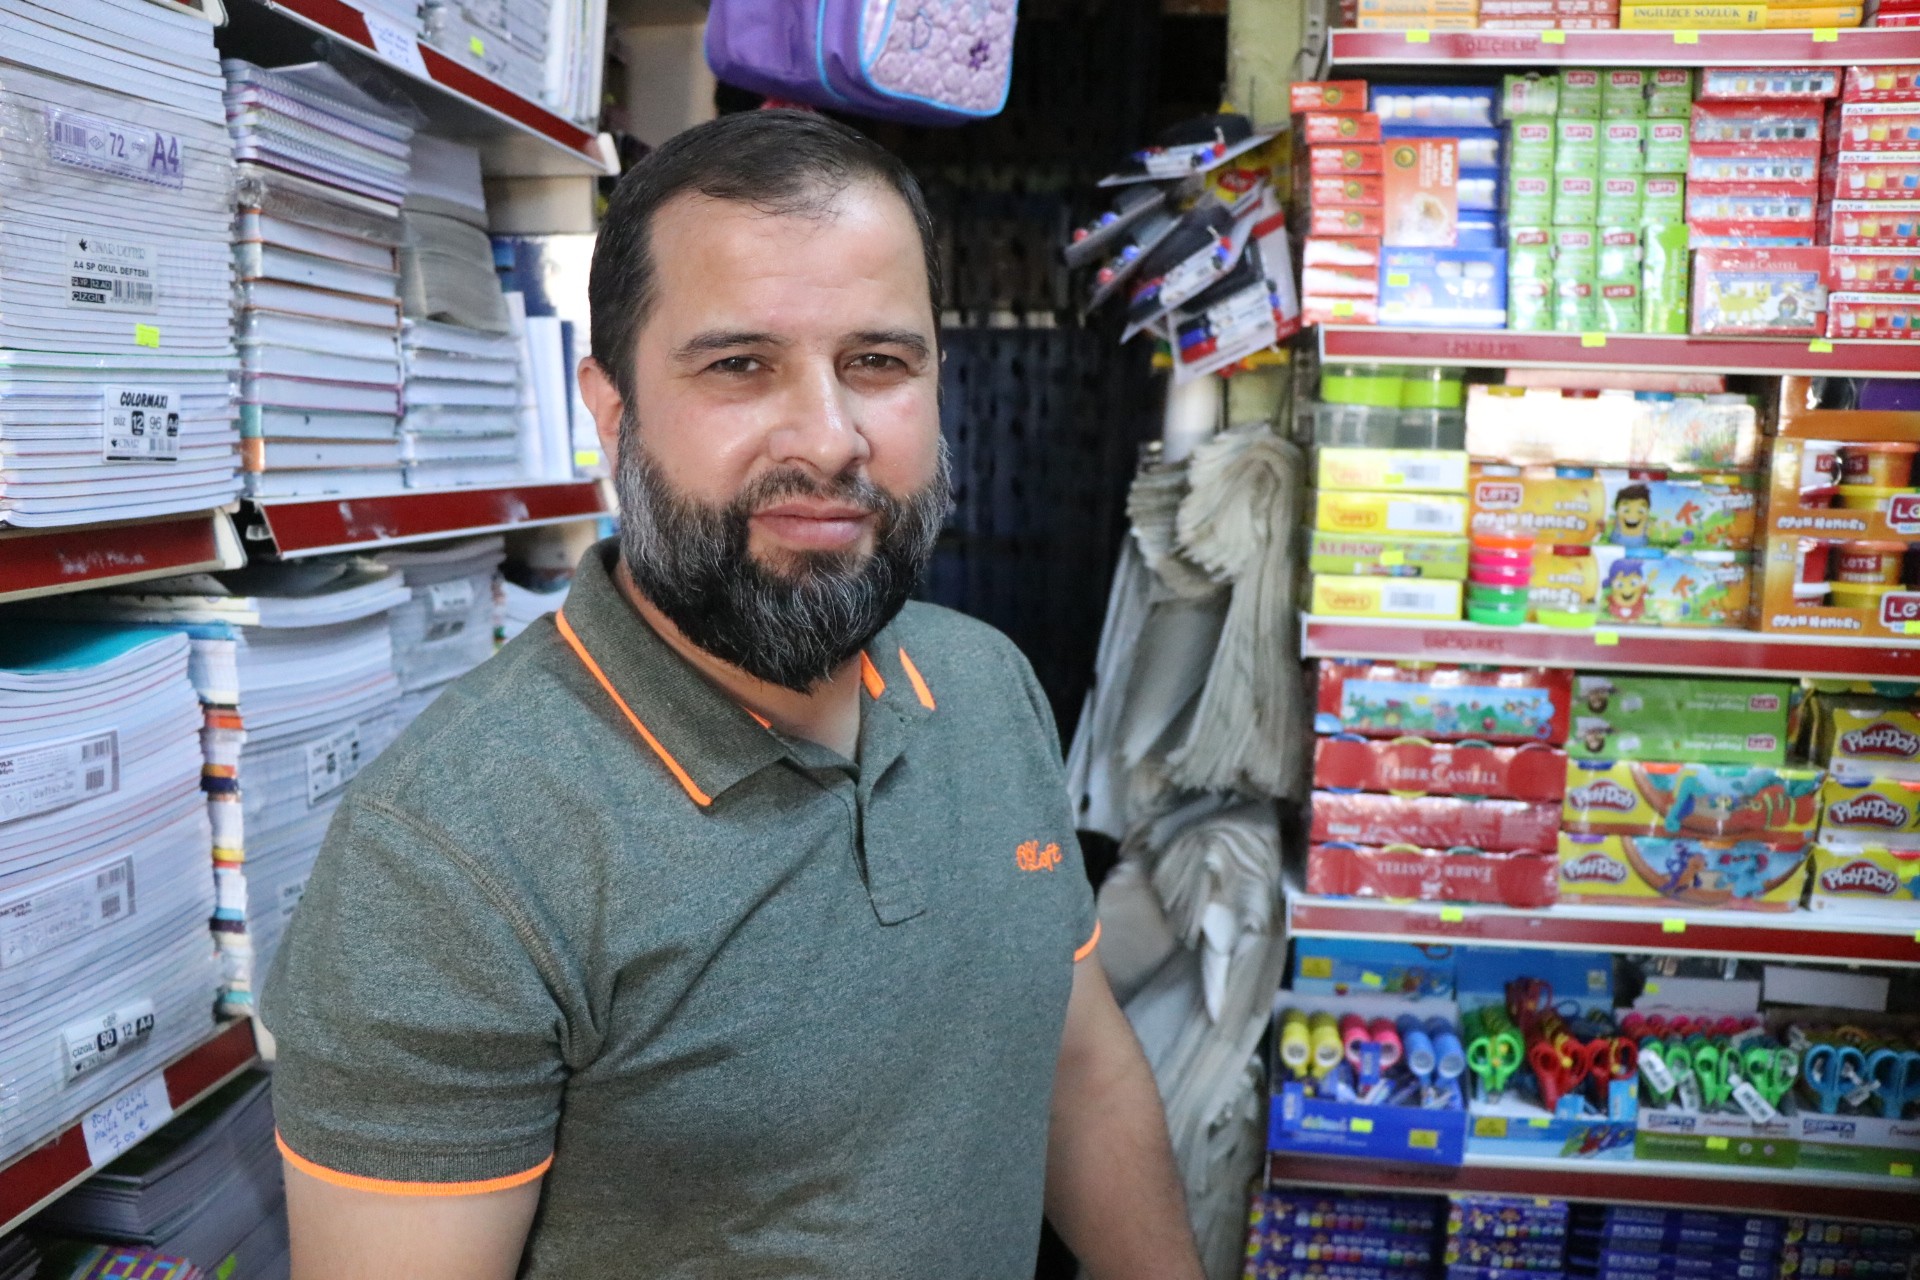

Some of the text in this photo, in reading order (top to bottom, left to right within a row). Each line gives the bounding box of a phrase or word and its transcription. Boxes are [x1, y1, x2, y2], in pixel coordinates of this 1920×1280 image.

[109, 132, 180, 176] 72 A4
[73, 261, 84, 269] A4
[86, 262, 96, 271] SP
[97, 263, 118, 274] OKUL
[120, 391, 168, 409] COLORMAXI
[132, 415, 144, 429] 12
[149, 416, 162, 430] 96
[100, 1030, 114, 1046] 80
[122, 1023, 133, 1037] 12
